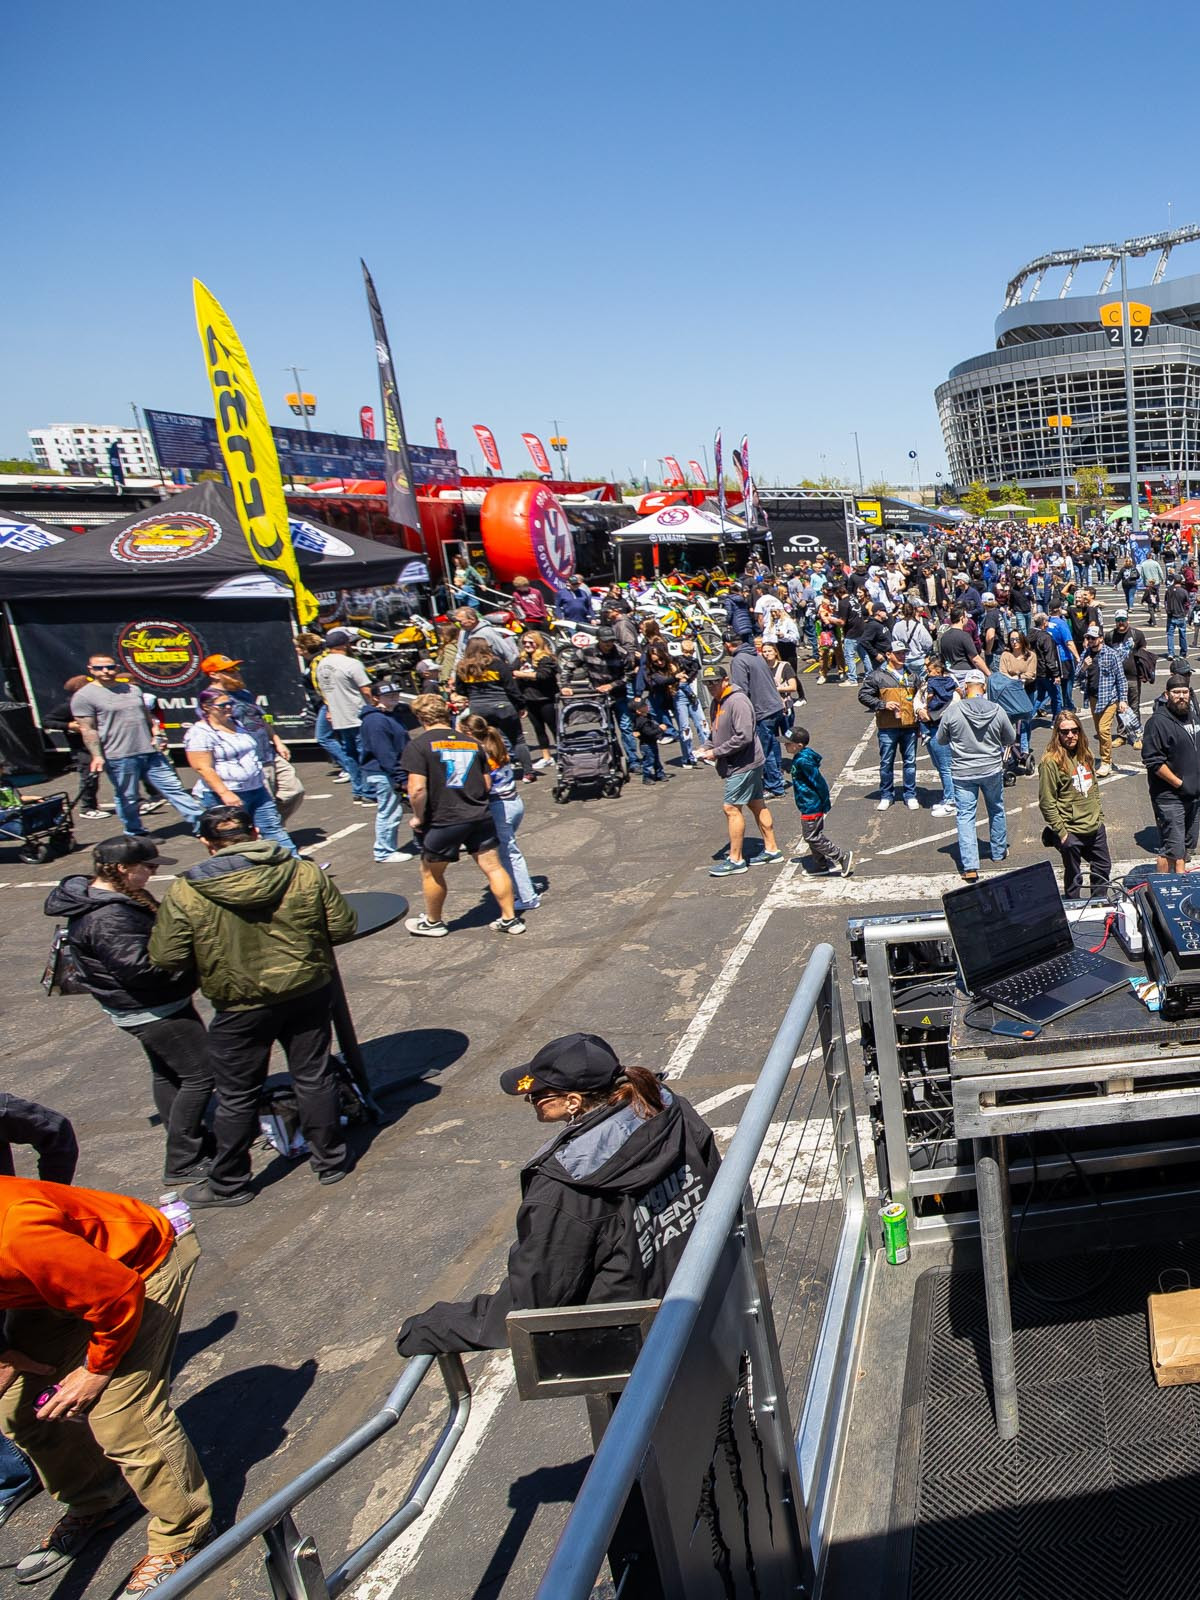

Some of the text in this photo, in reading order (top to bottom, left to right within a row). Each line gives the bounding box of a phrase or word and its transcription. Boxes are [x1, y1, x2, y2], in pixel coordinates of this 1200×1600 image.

[1109, 310, 1119, 323] C
[1132, 310, 1143, 323] C
[1110, 328, 1120, 342] 2
[1133, 328, 1143, 342] 2
[658, 534, 687, 542] YAMAHA
[121, 629, 192, 652] Legends
[133, 651, 190, 663] HEROES
[440, 749, 478, 789] 7
[638, 1184, 703, 1253] EVENT
